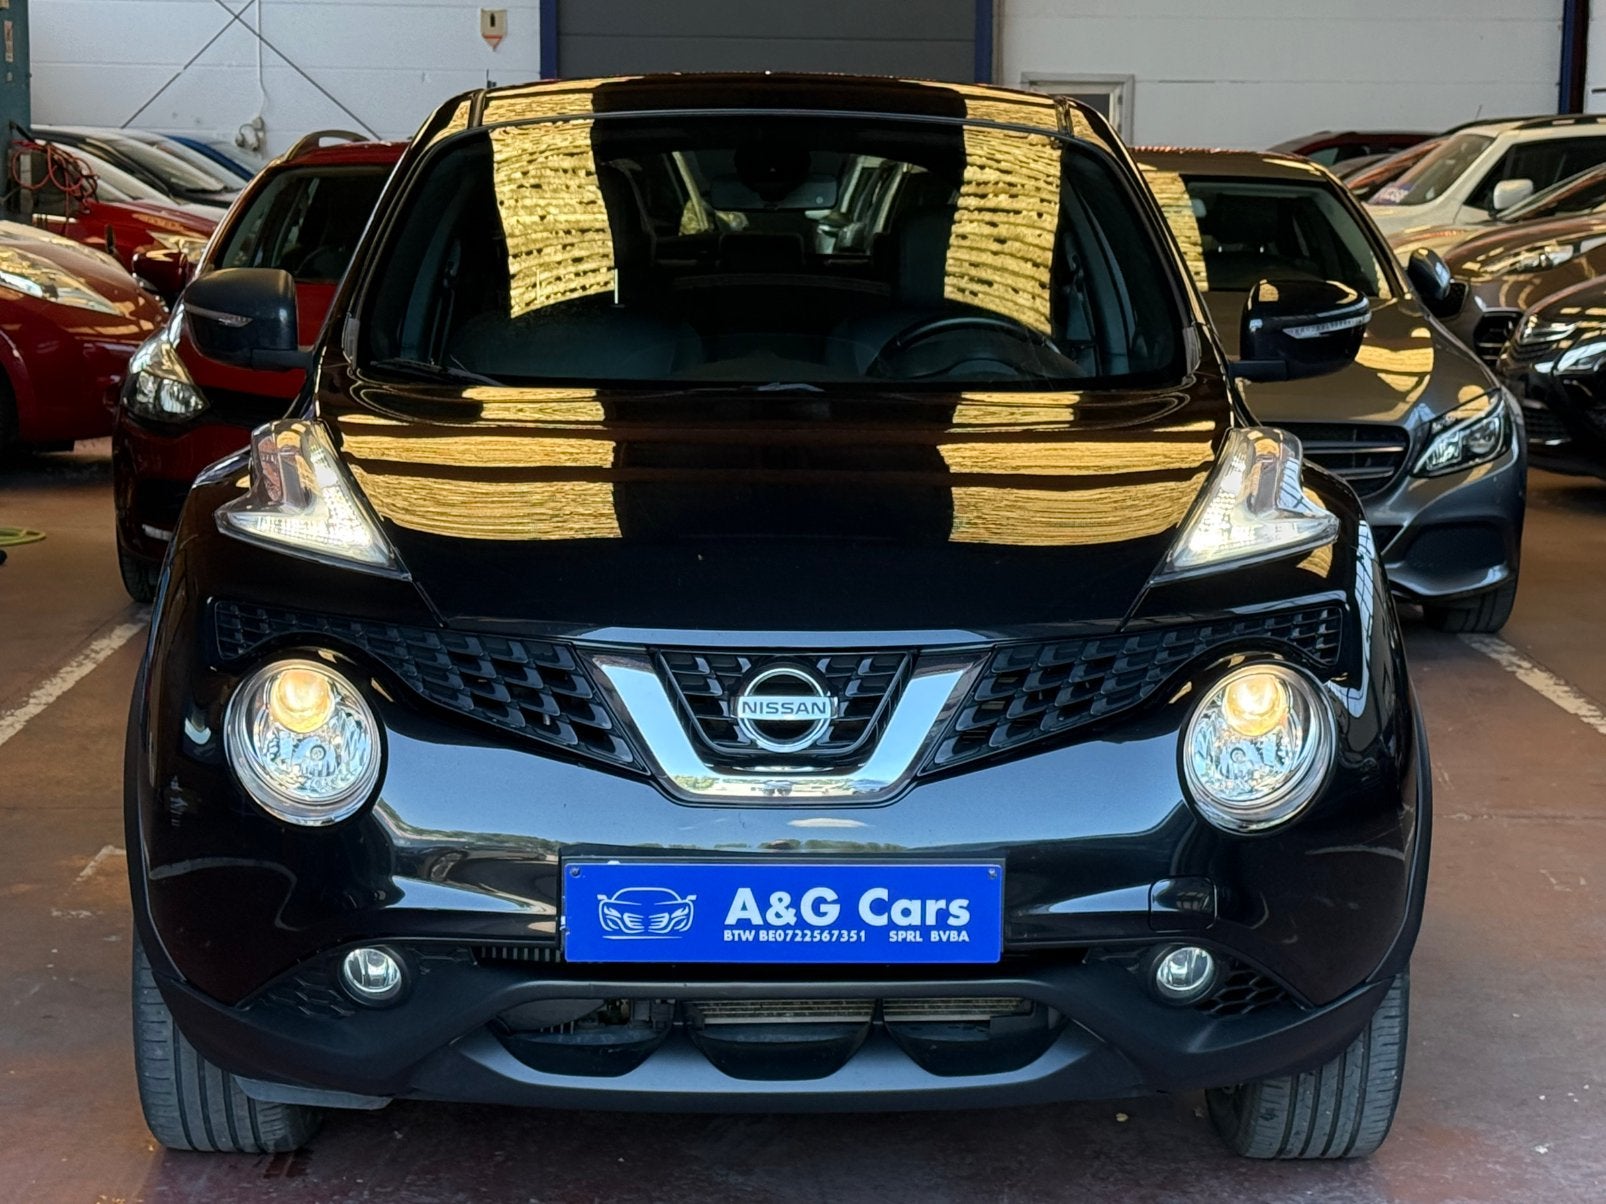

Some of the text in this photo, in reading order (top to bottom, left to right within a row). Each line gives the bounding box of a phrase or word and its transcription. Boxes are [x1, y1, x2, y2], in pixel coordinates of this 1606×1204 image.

[742, 701, 827, 715] NISSAN
[724, 886, 971, 928] A&G Cars
[723, 929, 970, 943] BTW BE0722567351 SPRL BVBA
